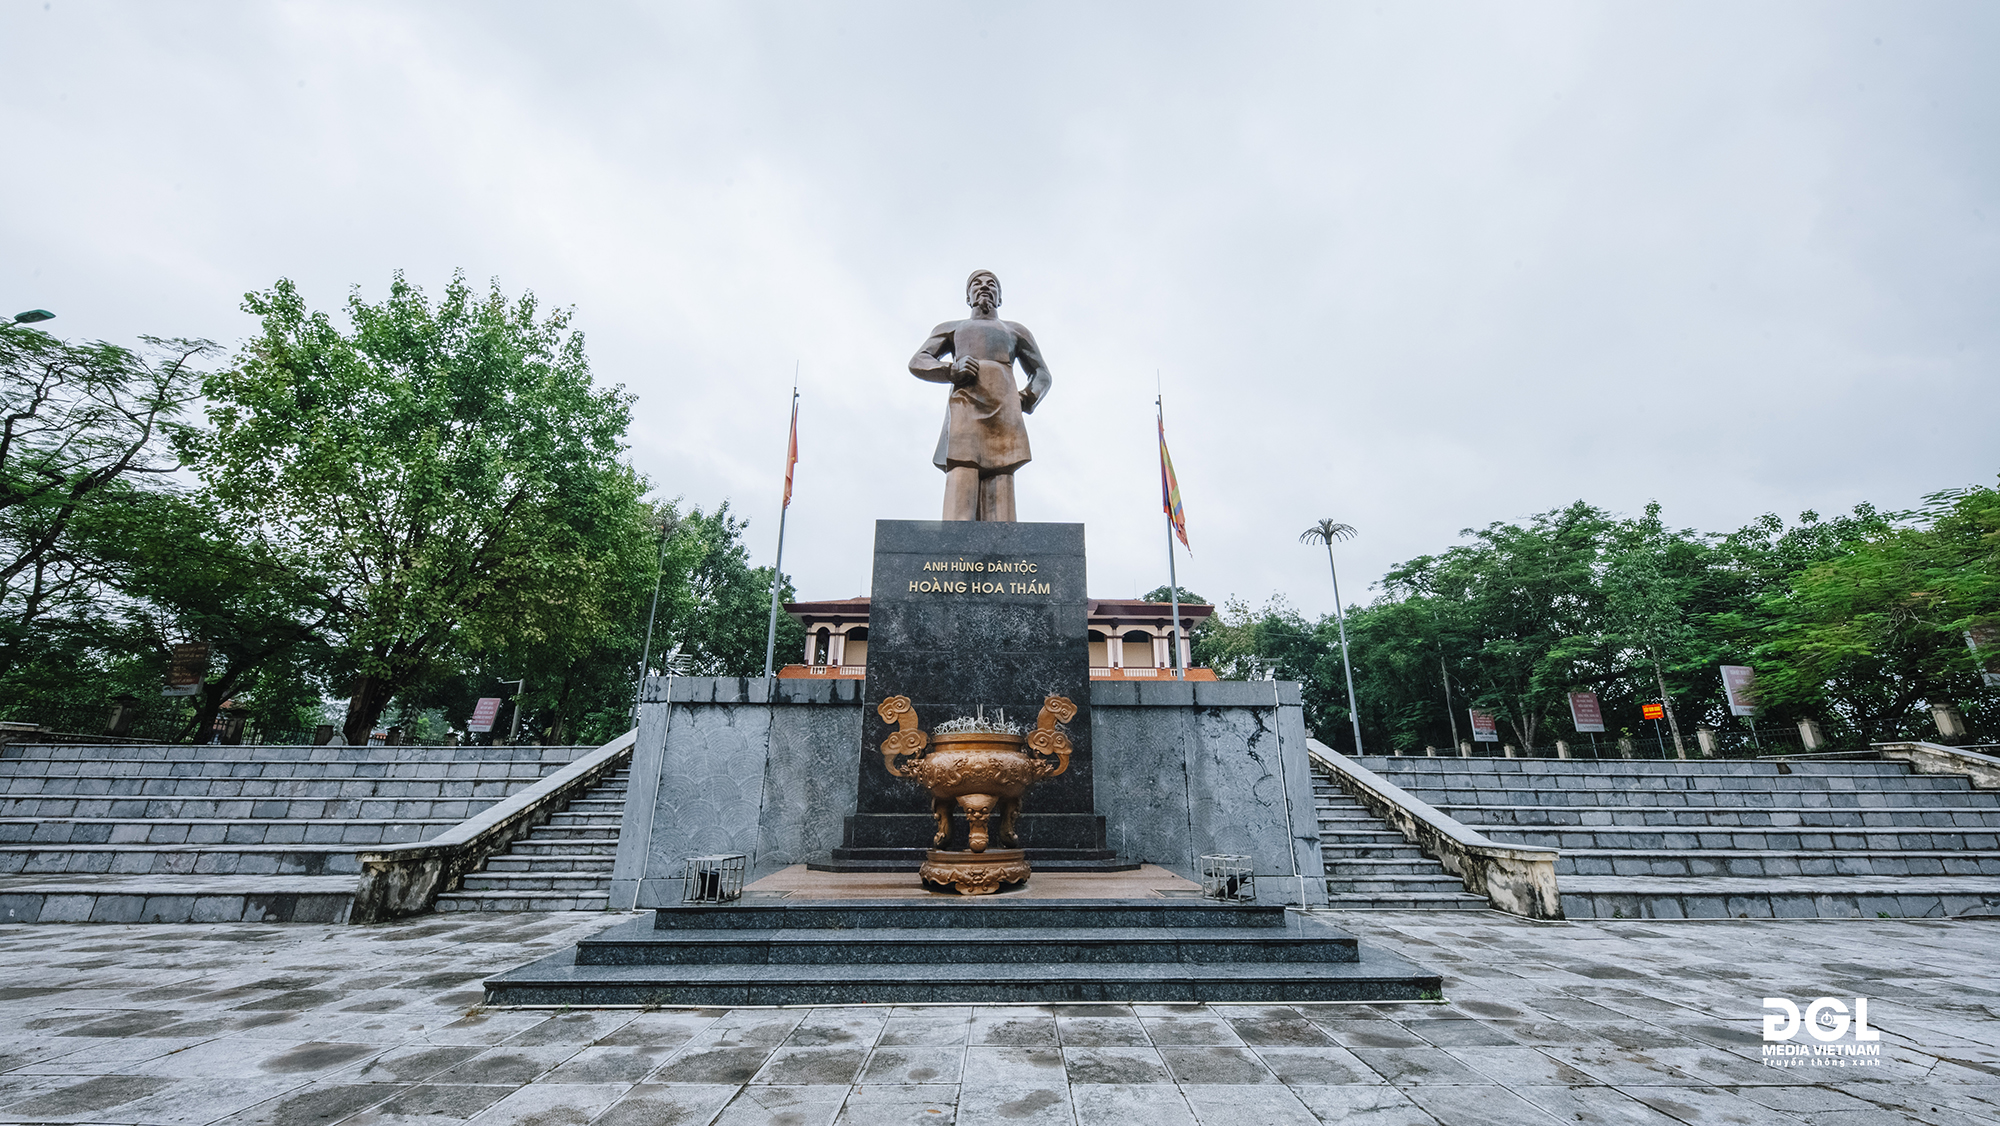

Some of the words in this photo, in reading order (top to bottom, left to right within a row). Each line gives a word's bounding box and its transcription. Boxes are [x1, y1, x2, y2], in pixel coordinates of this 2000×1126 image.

[923, 561, 948, 572] ANH
[951, 557, 984, 572] HÙNG
[987, 560, 1012, 573] DÂN
[1014, 560, 1038, 575] TỘC
[909, 577, 967, 593] HOÀNG
[972, 582, 1005, 594] HOA
[1010, 579, 1050, 594] THÁM
